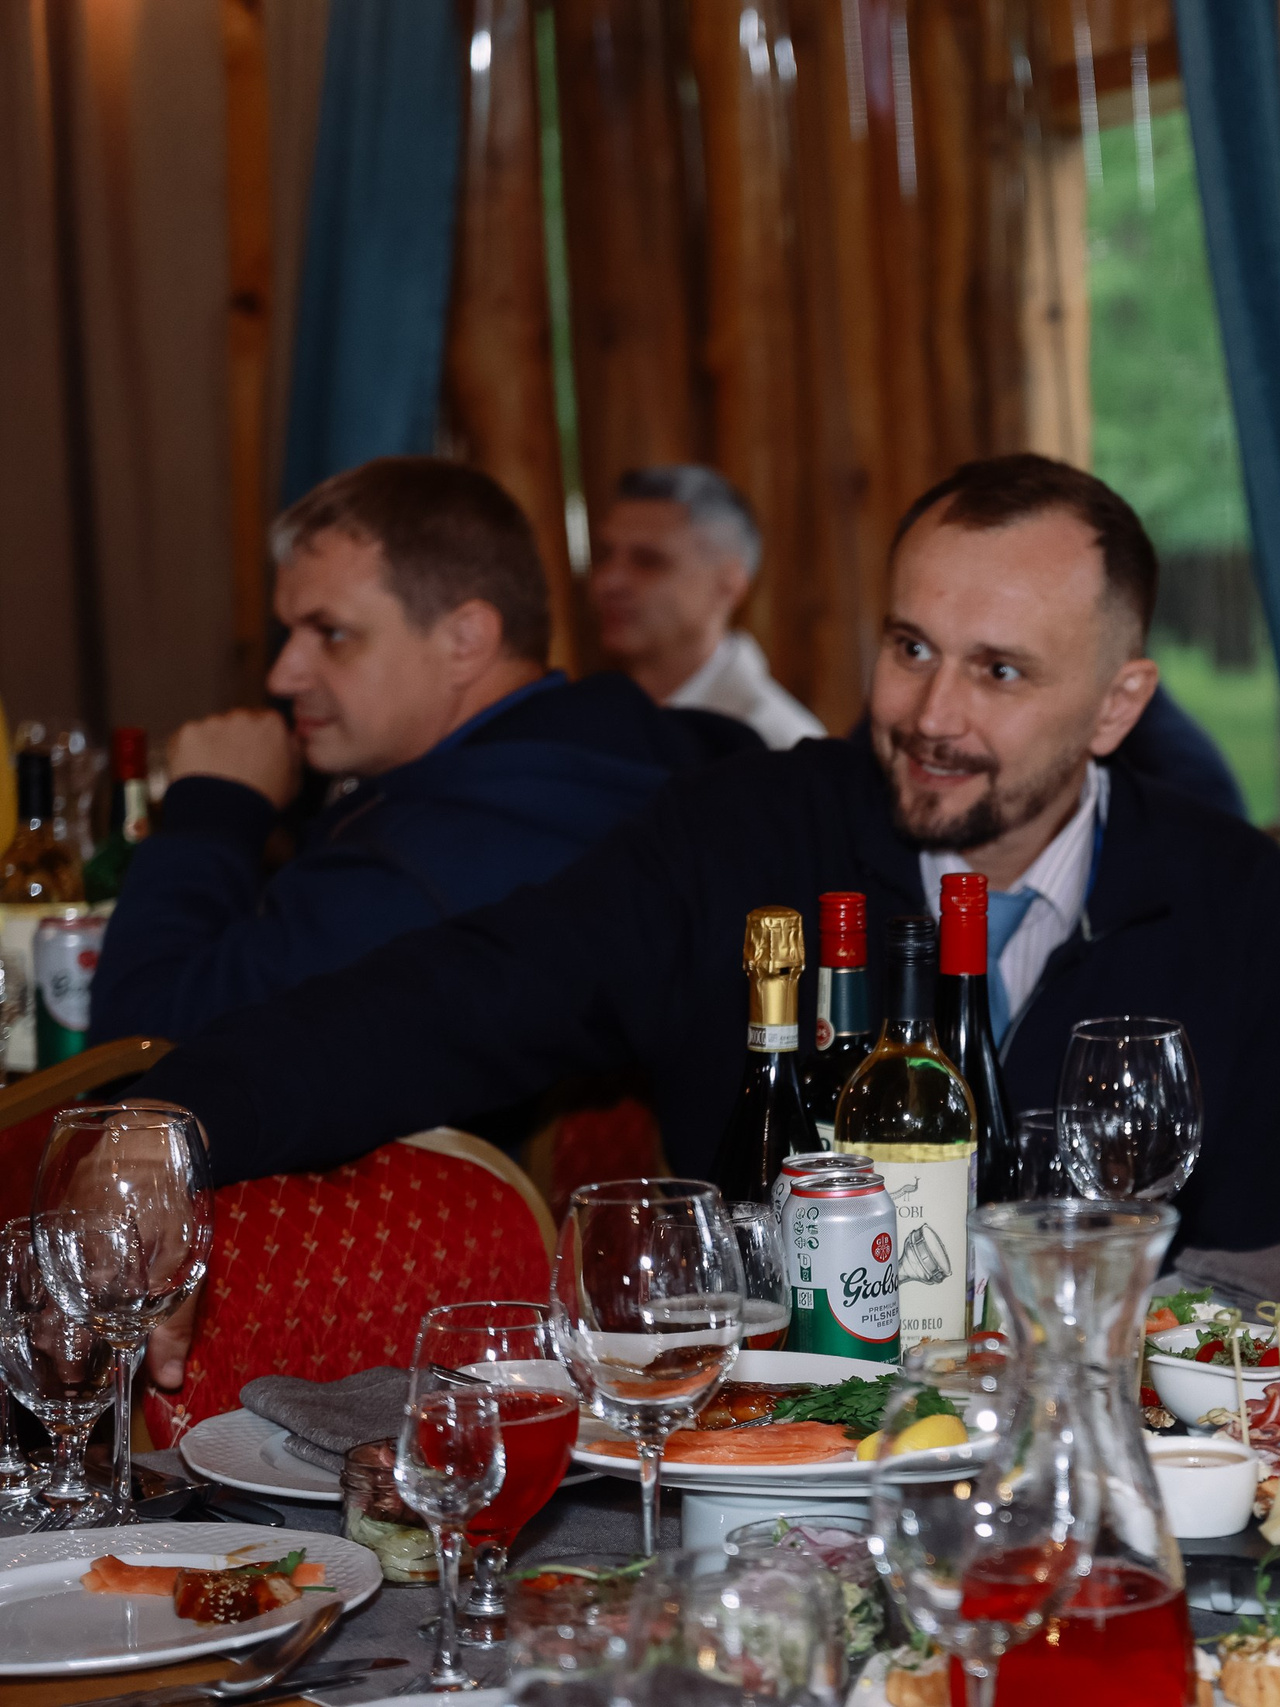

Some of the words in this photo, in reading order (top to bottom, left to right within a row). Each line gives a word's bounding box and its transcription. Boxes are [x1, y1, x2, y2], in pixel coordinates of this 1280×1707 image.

[896, 1206, 923, 1218] OBI
[877, 1318, 894, 1328] BEER
[922, 1317, 943, 1330] BELO
